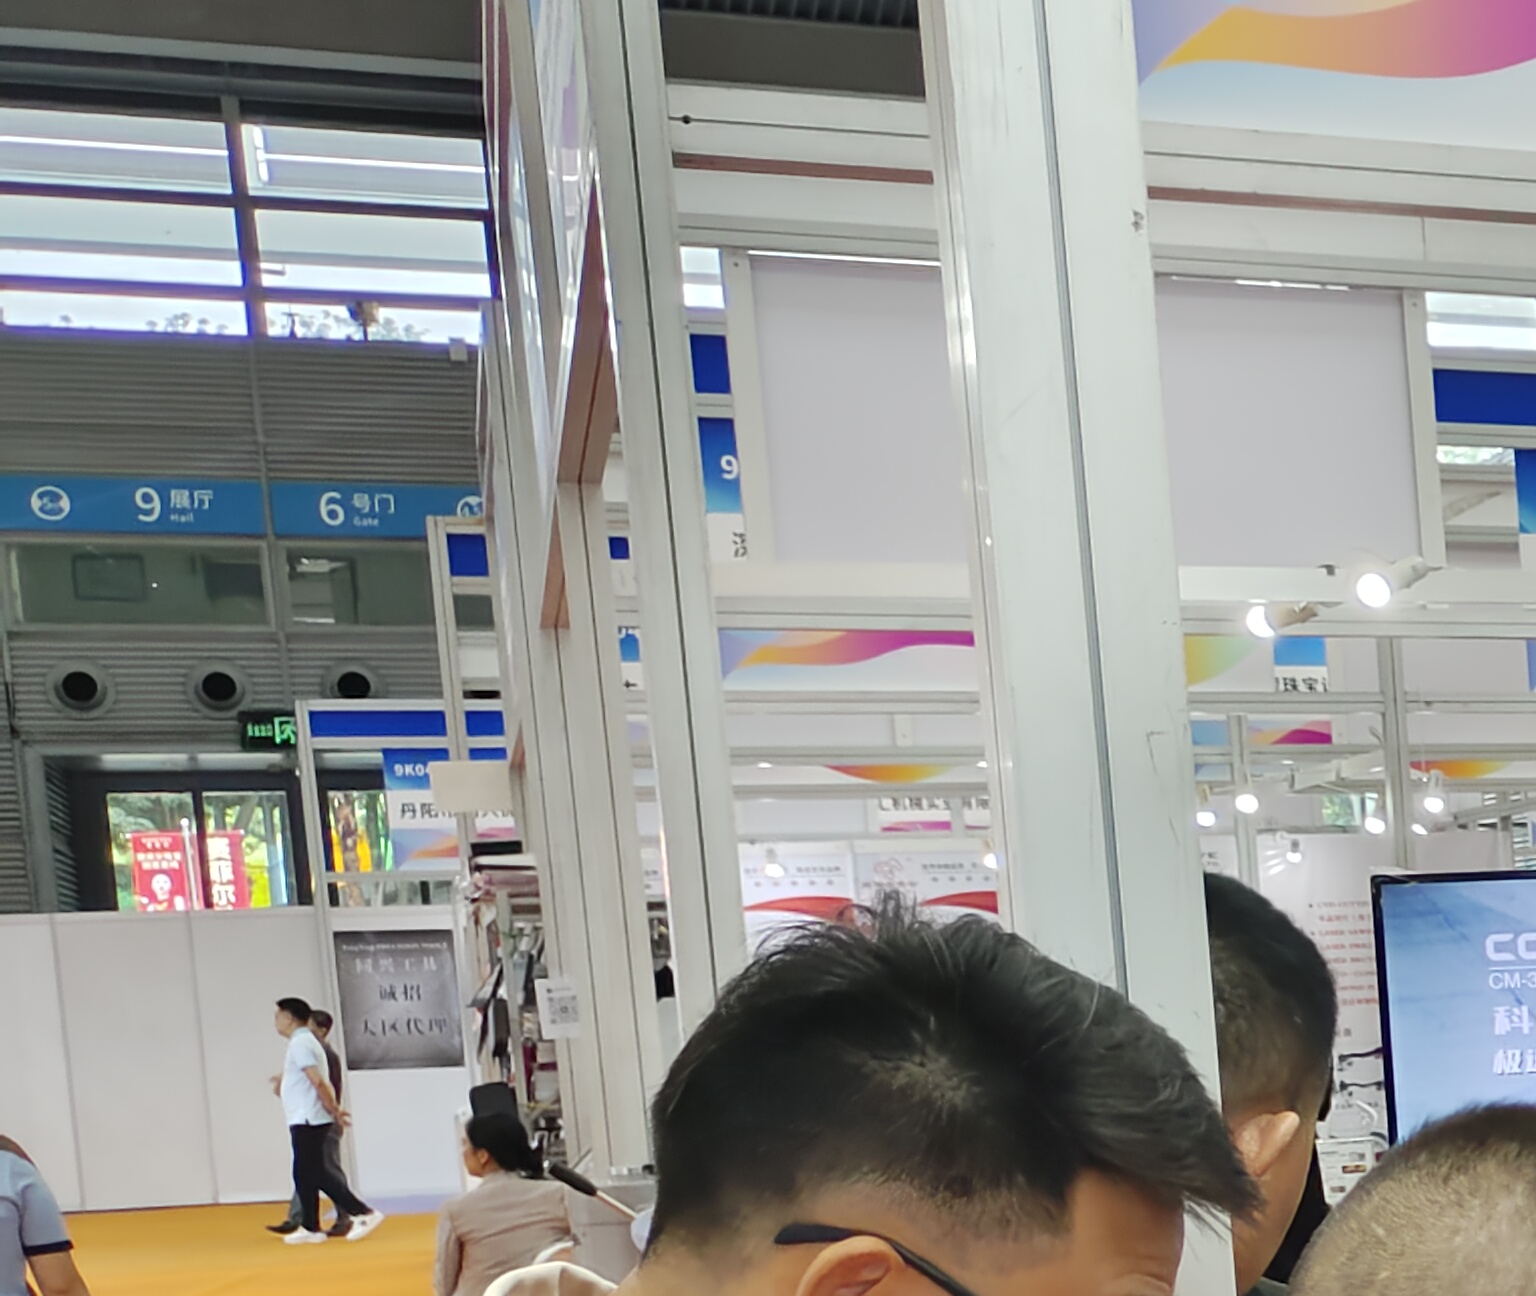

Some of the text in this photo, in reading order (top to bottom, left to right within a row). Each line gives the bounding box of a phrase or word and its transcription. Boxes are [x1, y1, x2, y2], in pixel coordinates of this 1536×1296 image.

[134, 486, 162, 523] 9
[170, 489, 213, 511] 展厅
[318, 491, 346, 526] 6
[352, 494, 396, 515] 号门
